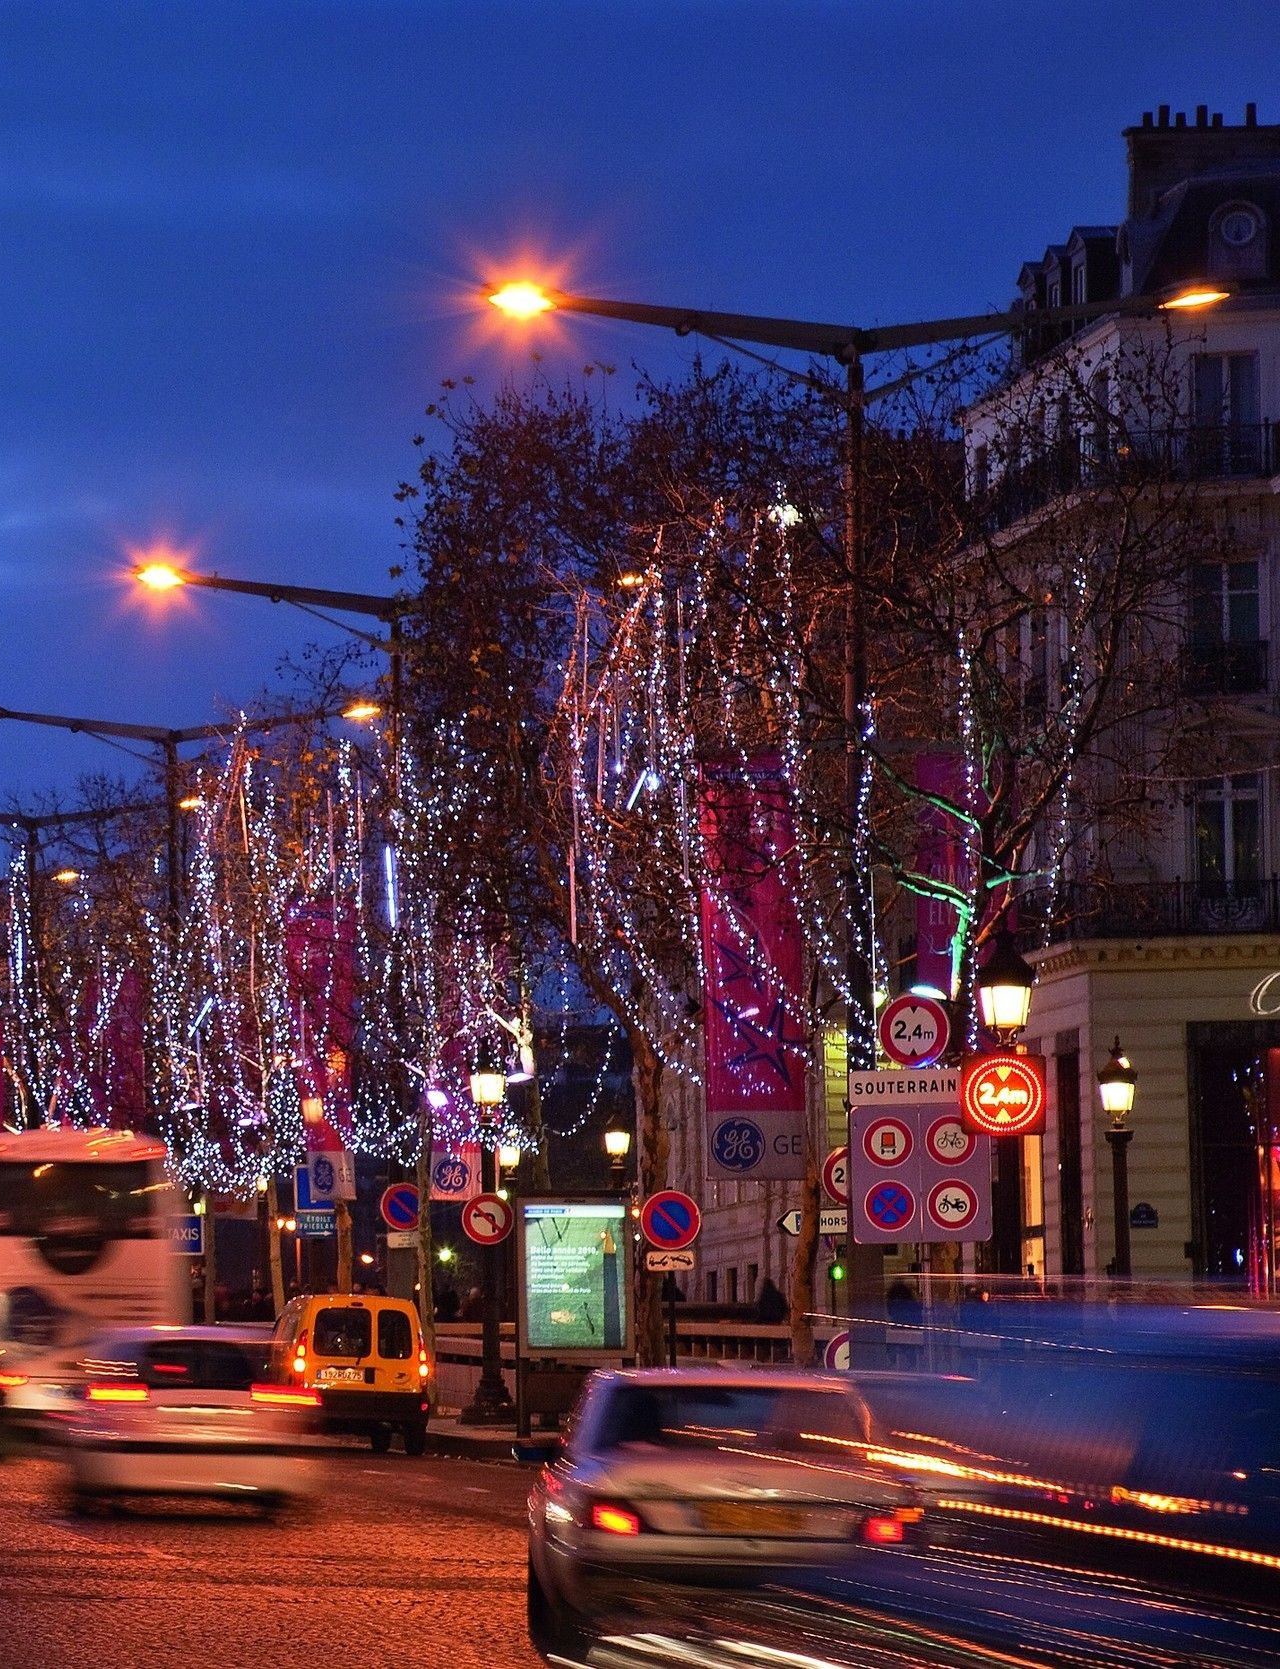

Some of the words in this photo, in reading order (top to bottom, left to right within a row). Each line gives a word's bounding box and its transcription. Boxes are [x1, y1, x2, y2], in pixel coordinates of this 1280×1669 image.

[894, 1020, 934, 1042] 2,4m
[854, 1078, 957, 1096] SOUTERRAIN
[978, 1081, 1028, 1107] 2,4m
[773, 1134, 803, 1156] GE
[299, 1222, 335, 1230] FRIEDLAN
[820, 1216, 847, 1227] HORS
